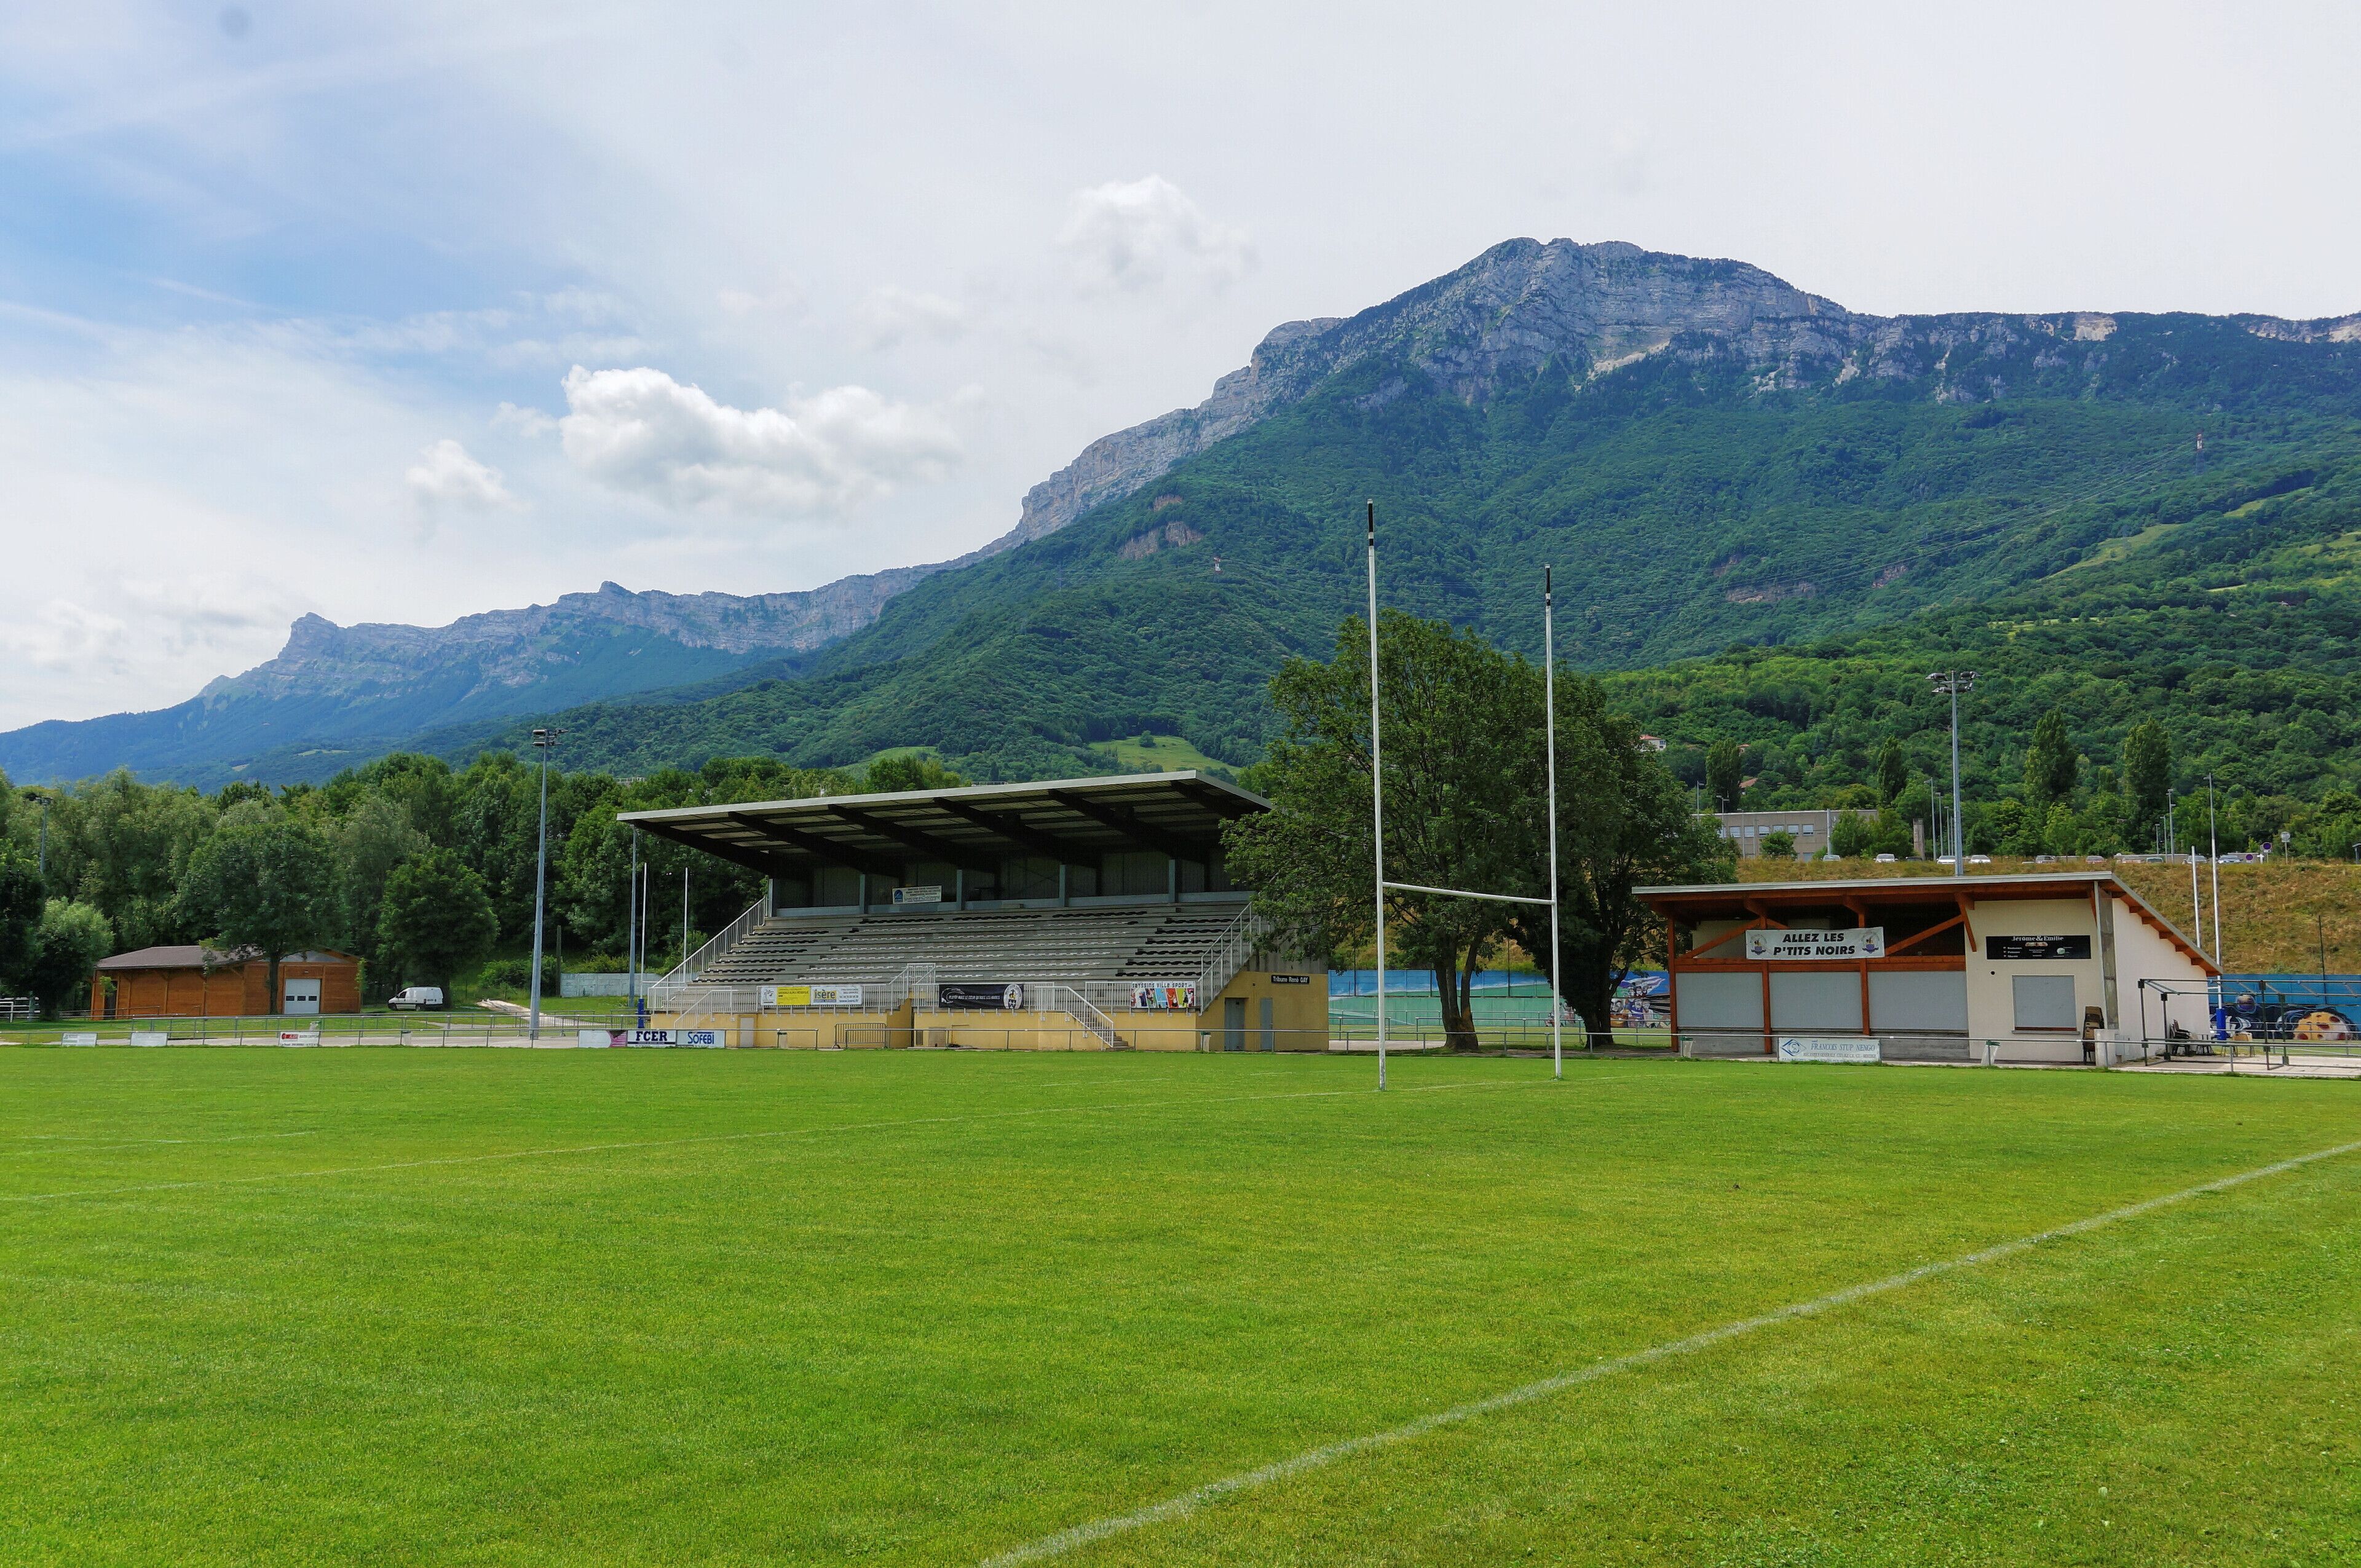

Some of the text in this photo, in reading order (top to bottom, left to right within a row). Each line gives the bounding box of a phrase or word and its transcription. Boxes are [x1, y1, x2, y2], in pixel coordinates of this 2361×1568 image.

[1782, 932, 1845, 943] ALLEZ LES
[1773, 945, 1856, 956] P'TITS NOIRS
[815, 989, 836, 999] isère
[636, 1031, 668, 1041] FCER
